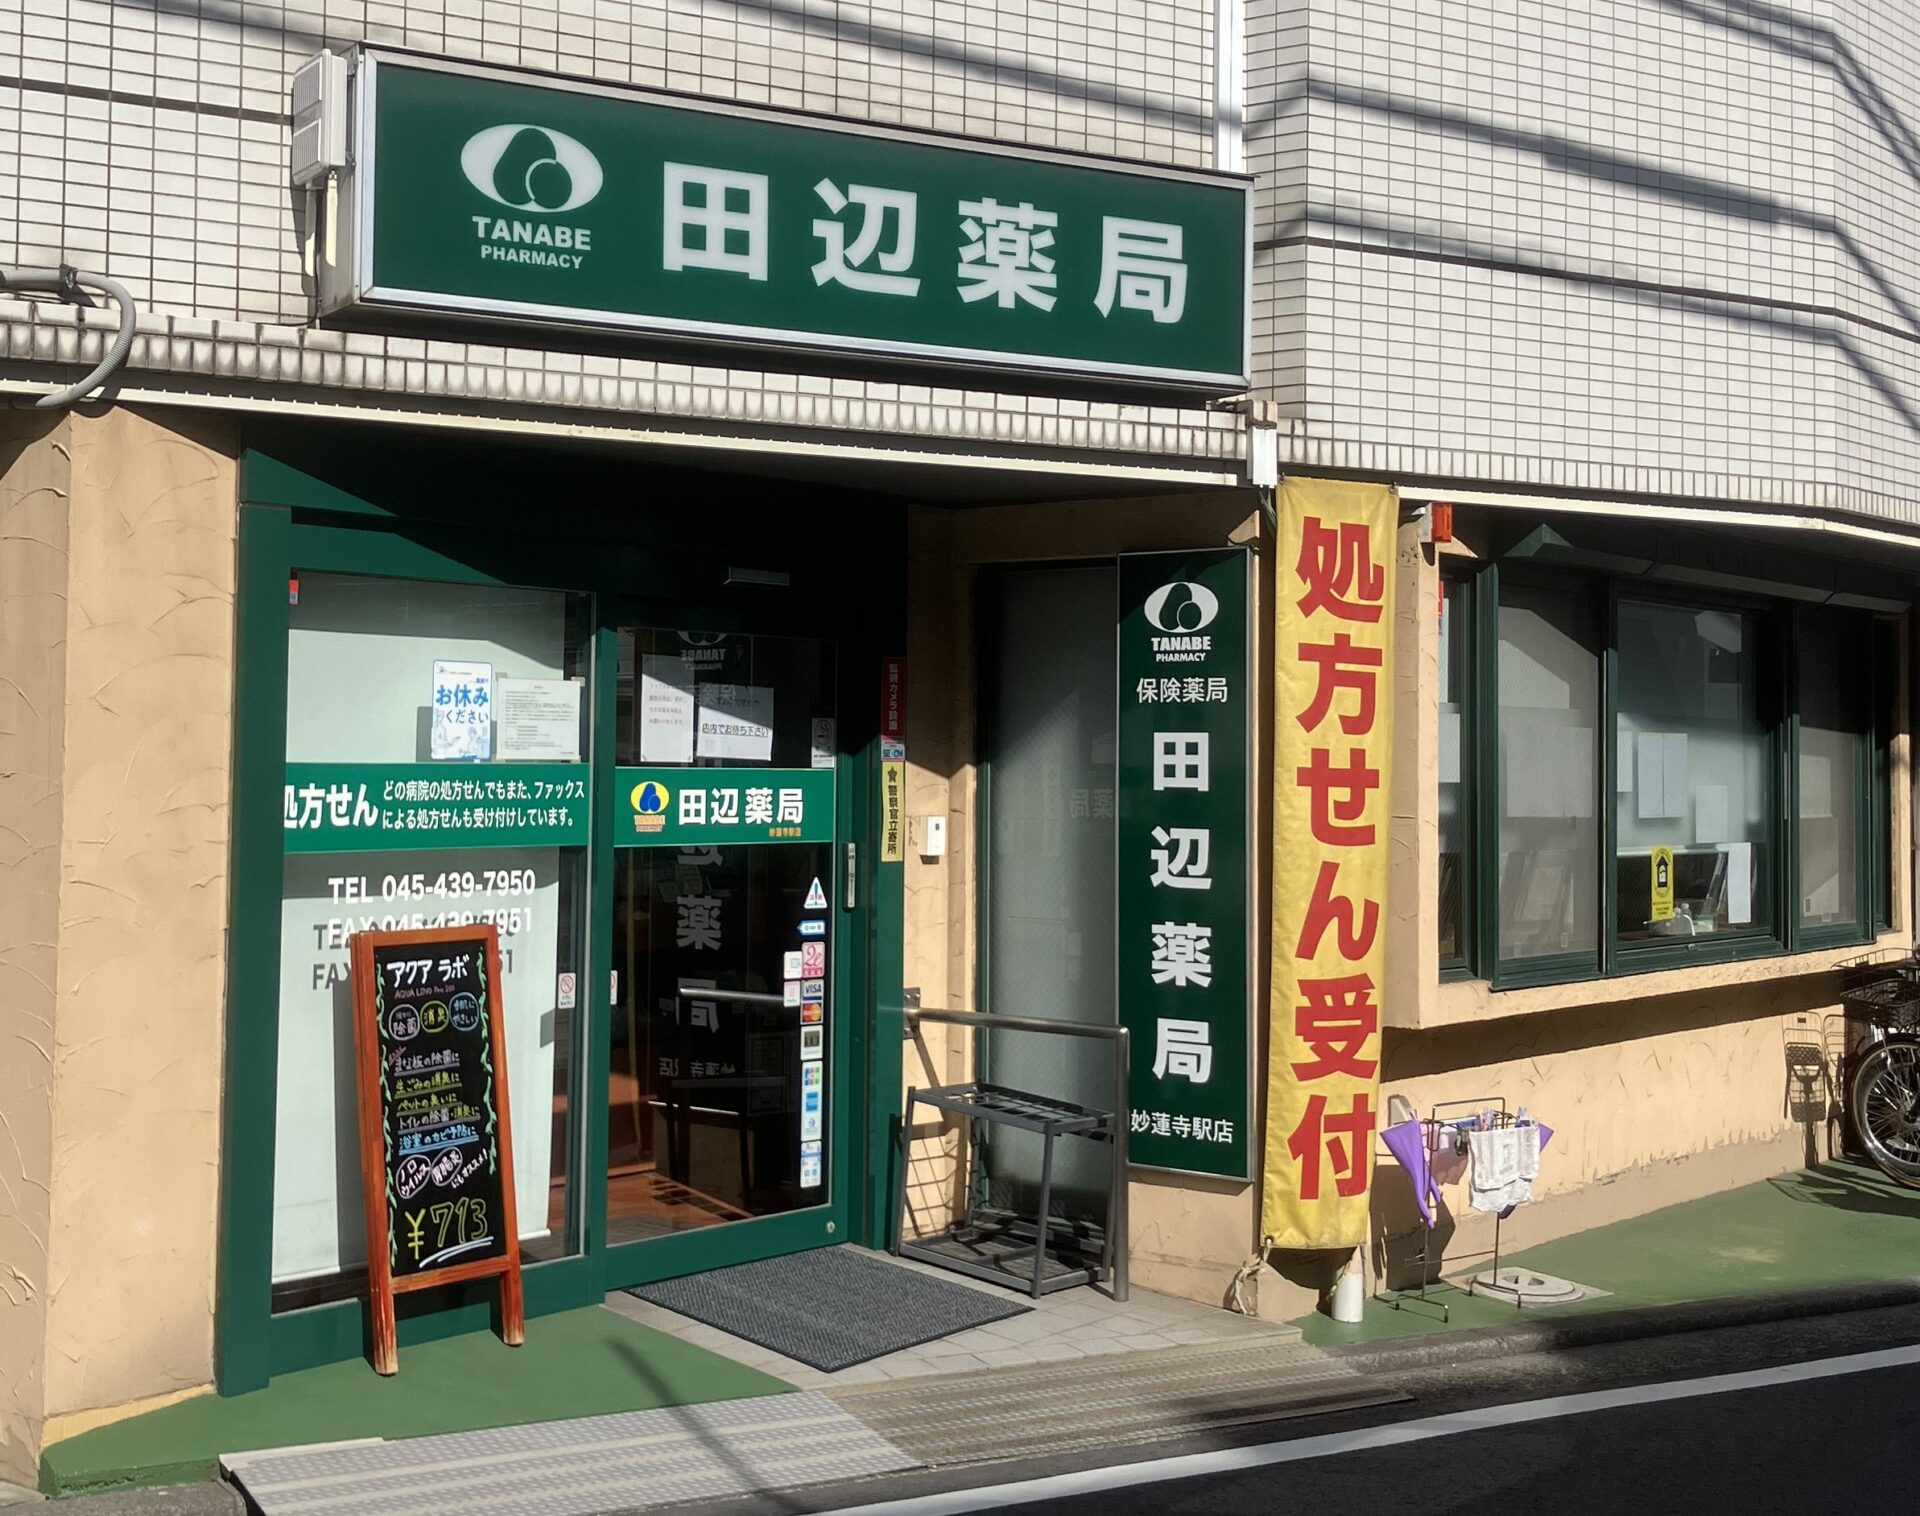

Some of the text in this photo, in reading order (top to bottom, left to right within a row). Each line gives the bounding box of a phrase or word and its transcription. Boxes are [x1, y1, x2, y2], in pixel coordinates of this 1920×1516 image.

[473, 215, 592, 253] TANABE
[663, 161, 1189, 324] 田辺薬局
[480, 246, 584, 270] PHARMACY
[1151, 636, 1212, 651] TANABE
[1156, 652, 1206, 662] PHARMACY
[435, 684, 489, 708] お休み
[1136, 677, 1229, 703] 保険薬局
[446, 709, 489, 725] ください
[383, 780, 585, 802] どの病院の処方せんでもまた、ファックス
[382, 806, 573, 830] による処方せんも受け付けしています。
[678, 787, 803, 825] 田辺薬局
[1287, 516, 1385, 1200] 処方せん受付
[328, 868, 536, 905] TEL 045-439-7950
[1150, 732, 1213, 1084] 田辺薬局
[386, 953, 470, 988] アクア ラボ
[805, 983, 822, 994] VISA
[1130, 1109, 1234, 1144] 妙蓮寺駅店
